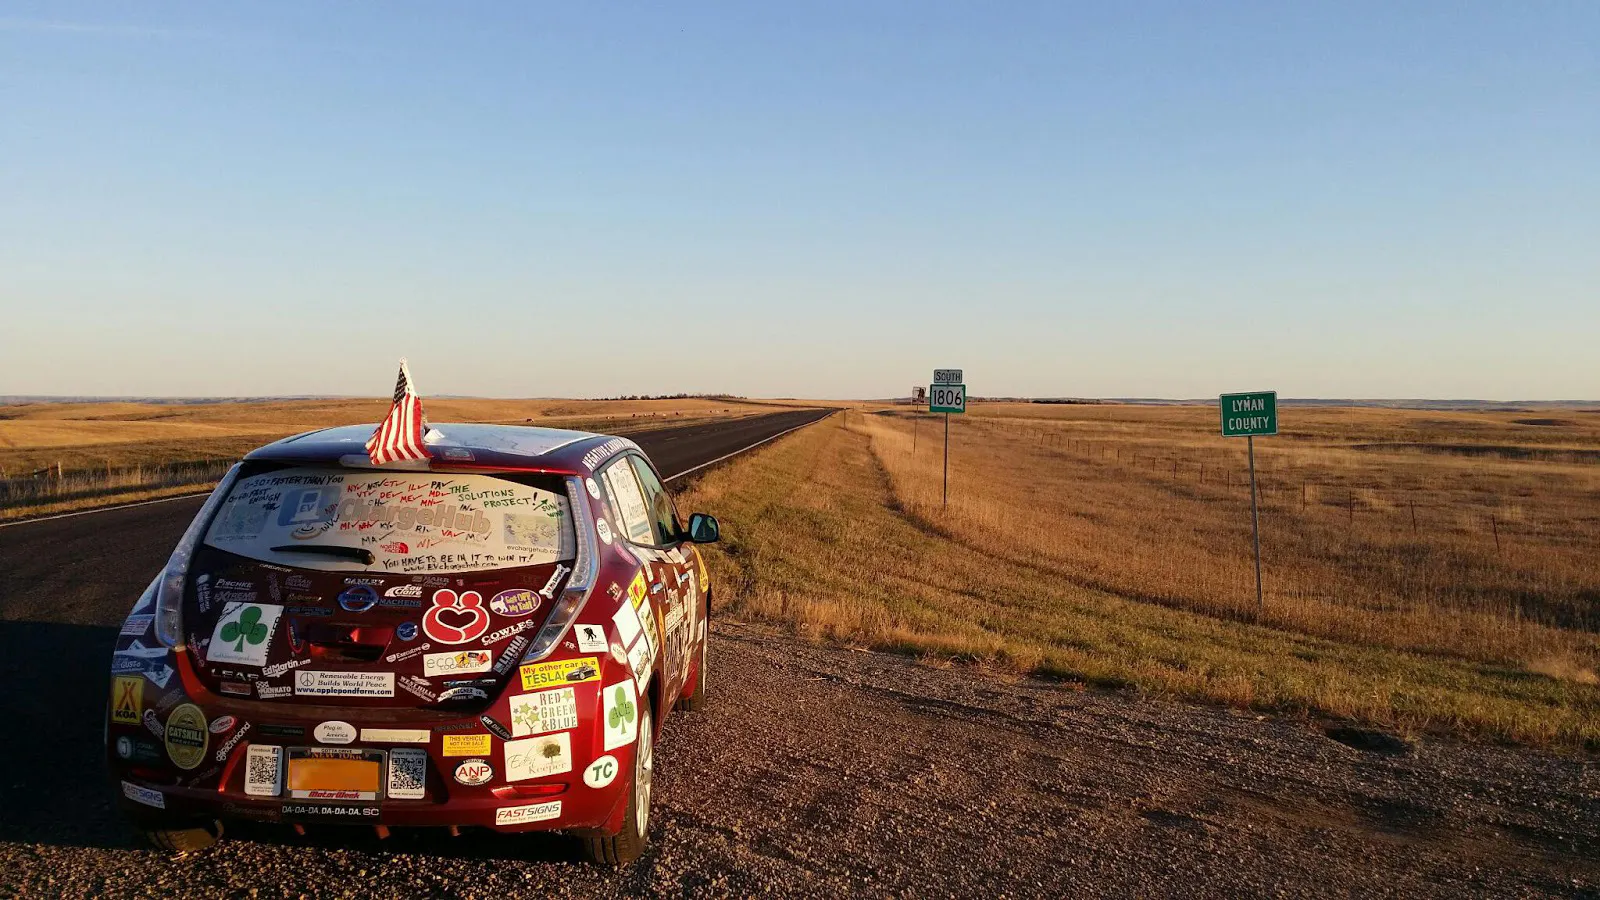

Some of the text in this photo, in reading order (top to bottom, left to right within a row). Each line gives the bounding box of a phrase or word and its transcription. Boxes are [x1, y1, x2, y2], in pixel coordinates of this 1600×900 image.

[935, 371, 961, 381] SOUTH
[933, 389, 962, 406] 1806
[1232, 398, 1265, 412] LYMAN
[1228, 416, 1270, 431] COUNTY
[271, 476, 302, 486] FASTER
[303, 475, 327, 486] THAN
[326, 474, 344, 485] YOU
[449, 484, 470, 494] THE
[458, 489, 514, 502] SOLUTIONS
[299, 504, 314, 512] EV
[401, 555, 424, 565] HAVE
[425, 555, 436, 563] TO
[440, 554, 453, 563] BE
[457, 554, 467, 562] IN
[471, 553, 481, 562] IT
[484, 554, 495, 562] TO
[498, 554, 515, 562] WIN
[481, 619, 534, 643] COWLES
[499, 635, 526, 664] LITHIA
[523, 667, 536, 675] My
[538, 664, 562, 672] other
[319, 672, 386, 681] Renewable Energy
[525, 671, 565, 685] TESLA!
[296, 686, 392, 696] www.applepondfarm.com
[539, 692, 561, 706] RED
[115, 710, 137, 719] KOA
[541, 704, 575, 718] GREEN
[168, 726, 204, 741] CATSKILL
[457, 766, 490, 777] ANP
[592, 761, 613, 781] TC
[308, 791, 360, 800] MotorWeek
[362, 807, 379, 816] SC
[497, 803, 560, 819] FASTSIGNS
